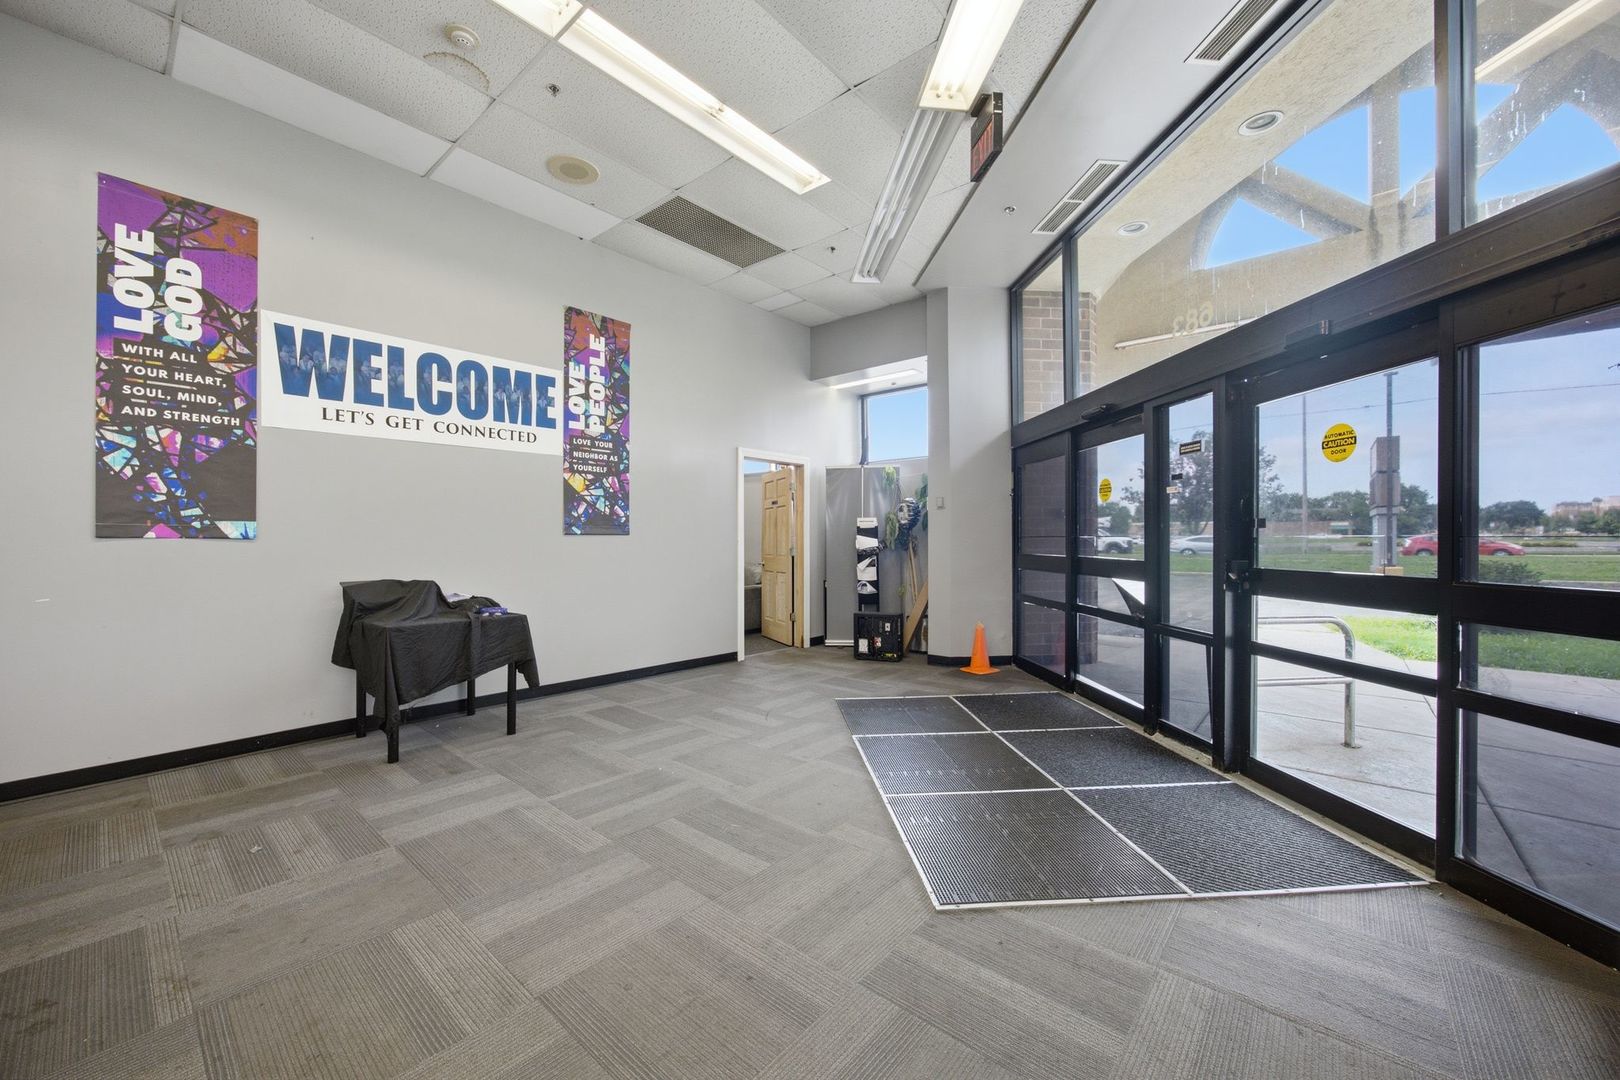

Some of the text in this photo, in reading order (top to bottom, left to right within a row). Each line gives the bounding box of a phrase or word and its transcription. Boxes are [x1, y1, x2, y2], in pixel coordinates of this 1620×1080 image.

[113, 222, 155, 335] LOVE
[164, 257, 203, 342] GOD
[121, 343, 198, 364] WITH ALL
[121, 363, 227, 388] YOUR HEART,
[274, 322, 557, 430] WELCOME
[589, 333, 606, 434] PEOPLE
[122, 385, 222, 407] SOUL, MIND,
[568, 361, 586, 431] LOVE
[121, 405, 240, 427] AND STRENGTH
[321, 407, 538, 444] LET'S GET CONNECTED
[573, 438, 614, 449] LOVE YOUR
[1323, 437, 1355, 448] CAUTION
[1325, 429, 1354, 439] AUTOMATIC
[573, 451, 618, 462] NEIGHBOR AS
[573, 464, 608, 474] YOURSELF
